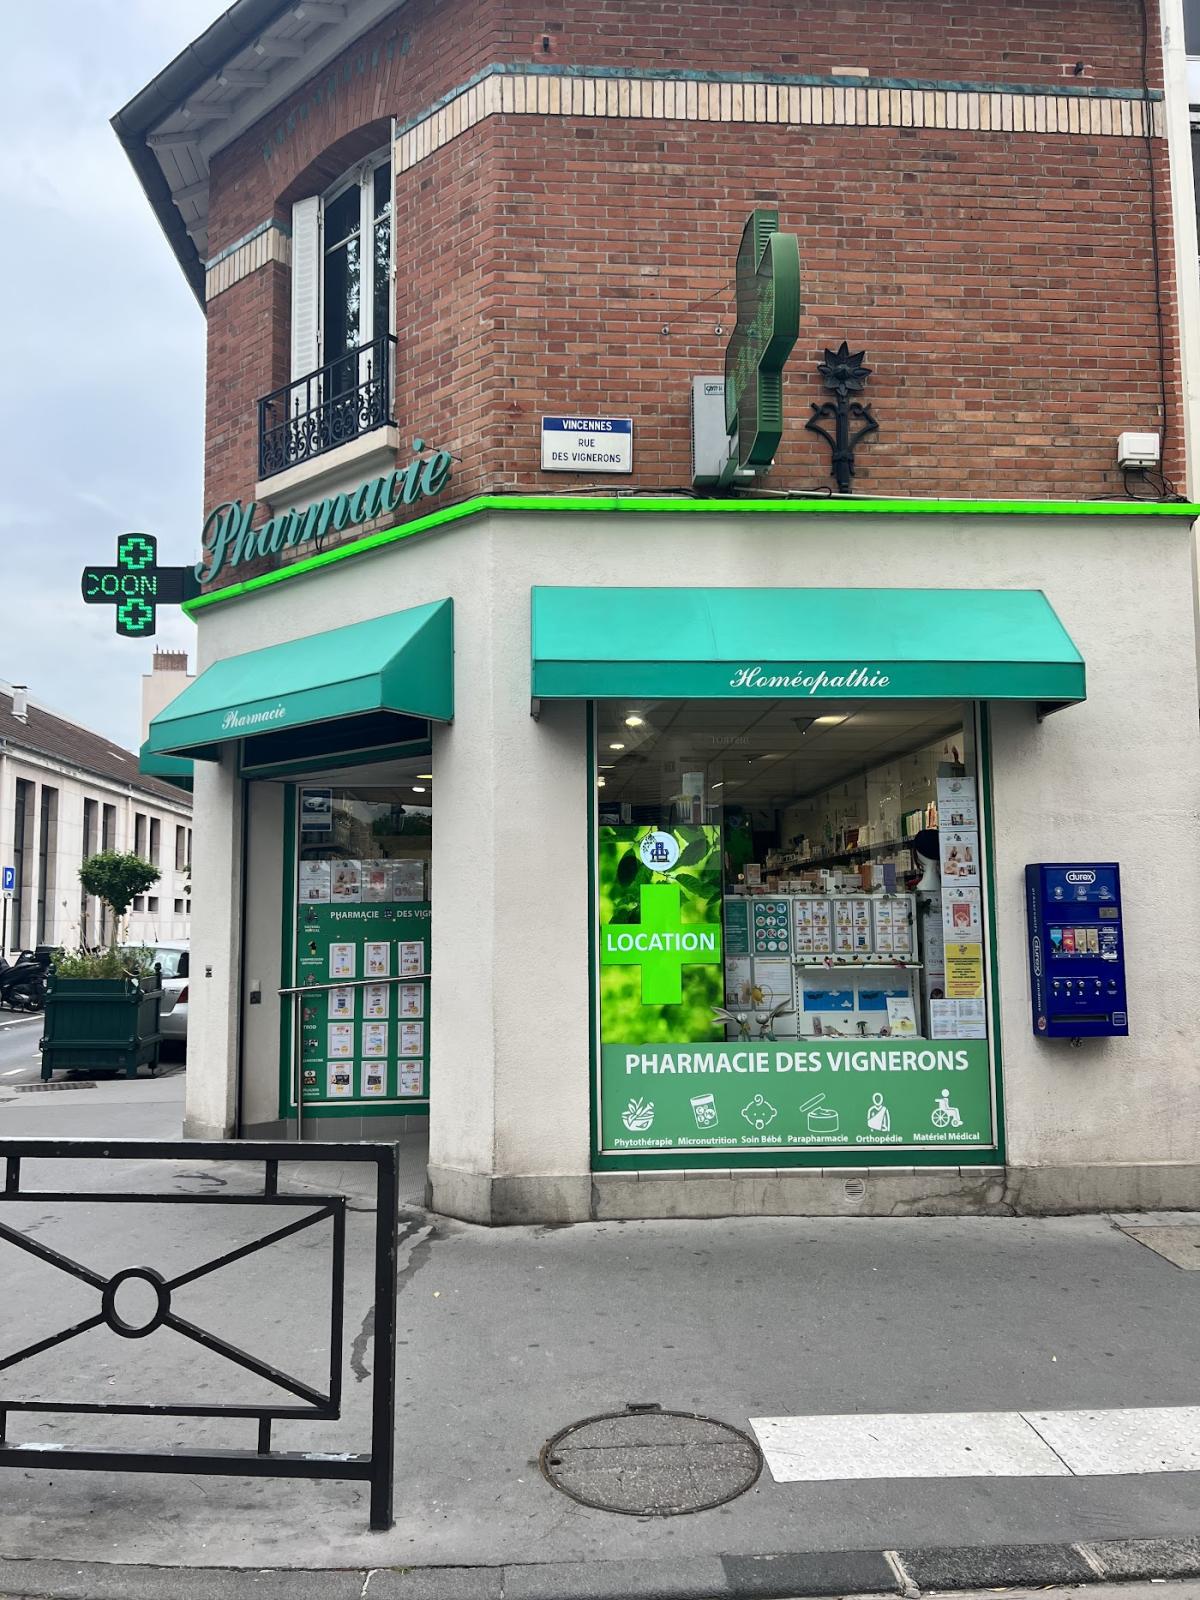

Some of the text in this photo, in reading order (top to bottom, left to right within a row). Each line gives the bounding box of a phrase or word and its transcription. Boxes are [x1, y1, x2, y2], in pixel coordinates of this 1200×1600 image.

[562, 420, 612, 431] VINCENNES
[578, 439, 595, 448] RUE
[552, 452, 621, 463] DES VIGNERONS
[194, 438, 452, 584] Pharmacie
[729, 666, 891, 695] Homéopathie
[222, 703, 286, 730] Pharmacie
[6, 871, 13, 885] P
[1068, 872, 1093, 882] durex
[330, 910, 380, 919] PHARMACIE
[396, 910, 412, 918] DES
[607, 932, 715, 952] LOCATION
[625, 1050, 969, 1074] PHARMACIE DES VIGNERONS
[678, 1136, 738, 1145] Micronutrition
[741, 1135, 782, 1144] Soin Bébé
[788, 1134, 849, 1144] Parapharmacie
[856, 1134, 903, 1144] Orthopédie
[913, 1131, 980, 1141] Matériel Médical
[614, 1138, 673, 1147] Phytothérapie
